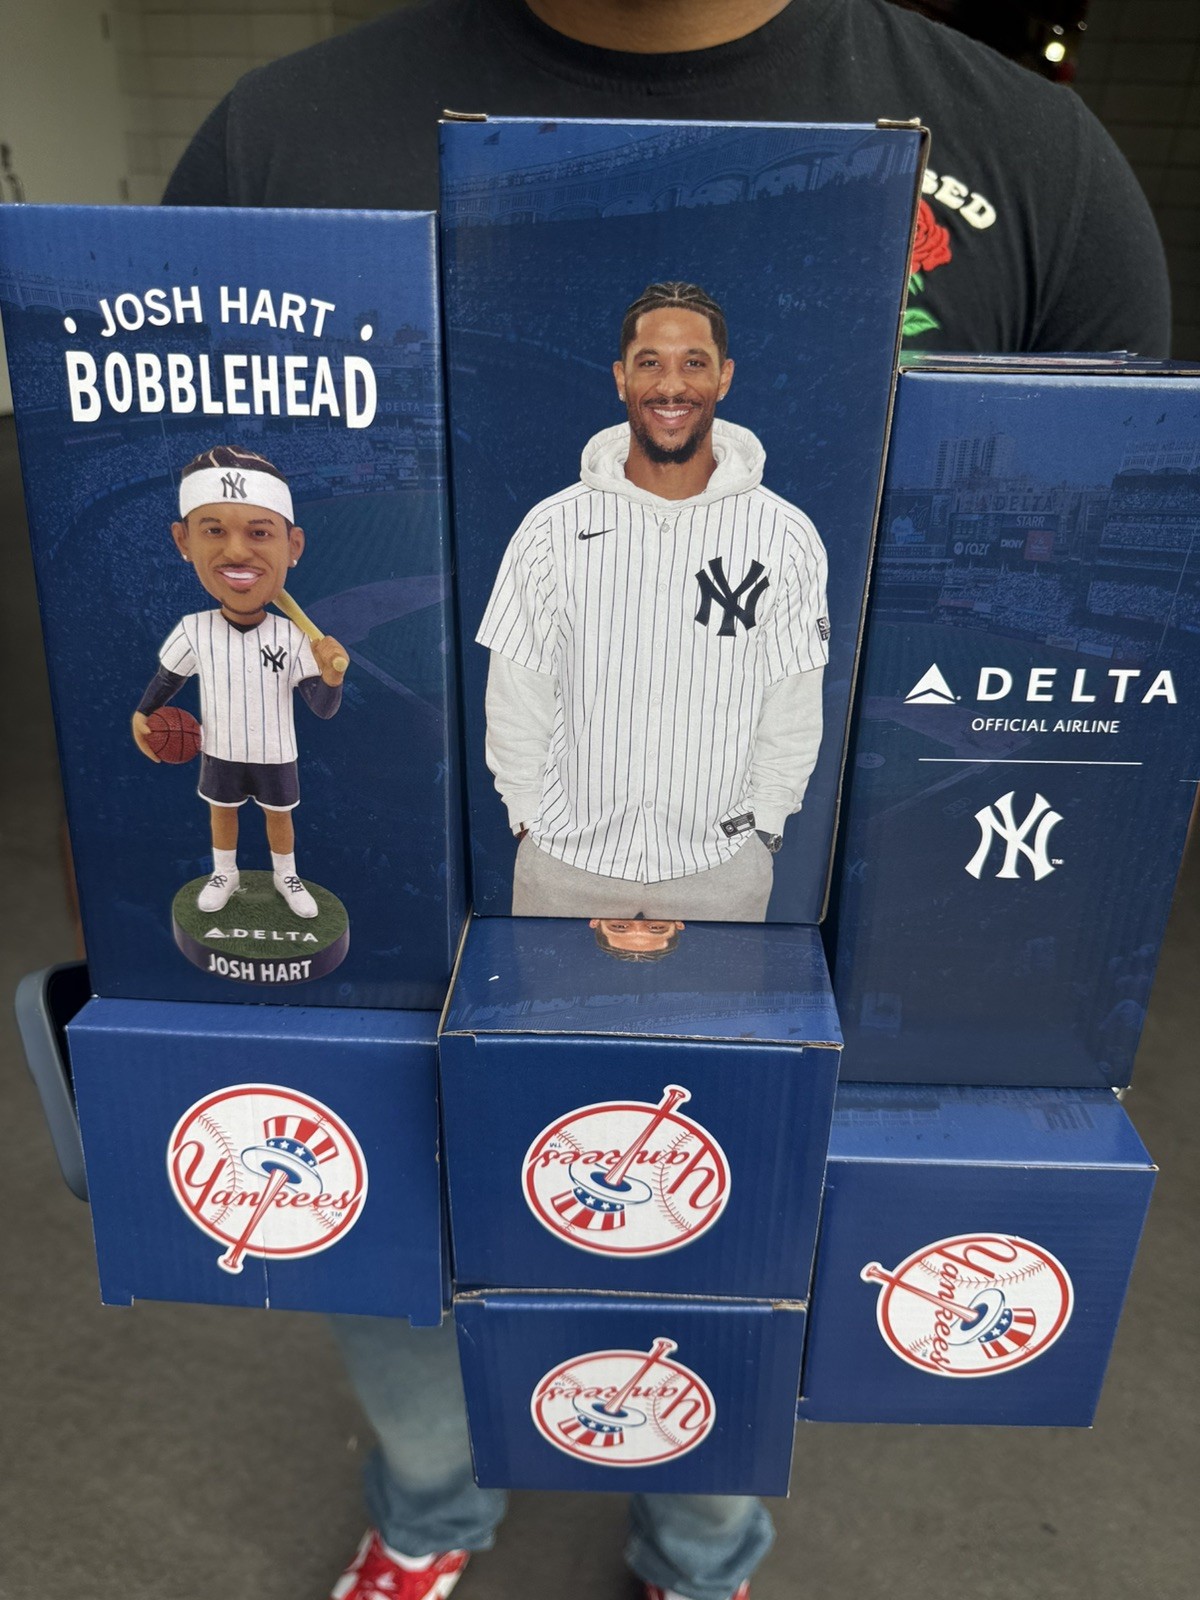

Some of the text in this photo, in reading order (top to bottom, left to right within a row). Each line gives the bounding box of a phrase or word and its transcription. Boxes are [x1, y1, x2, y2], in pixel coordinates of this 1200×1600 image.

[99, 285, 336, 339] JOSH HART
[64, 350, 378, 429] BOBBLEHEAD
[219, 471, 248, 500] NY
[1016, 515, 1045, 527] STARR
[694, 556, 769, 637] NY
[261, 645, 288, 673] NY
[976, 666, 1178, 704] DELTA
[971, 718, 1120, 734] OFFICIAL AIRLINE
[964, 790, 1064, 882] NY
[233, 929, 319, 943] DELTA
[208, 954, 312, 983] JOSH HART
[172, 1140, 362, 1213] Yankees
[528, 1144, 725, 1210] Yankees
